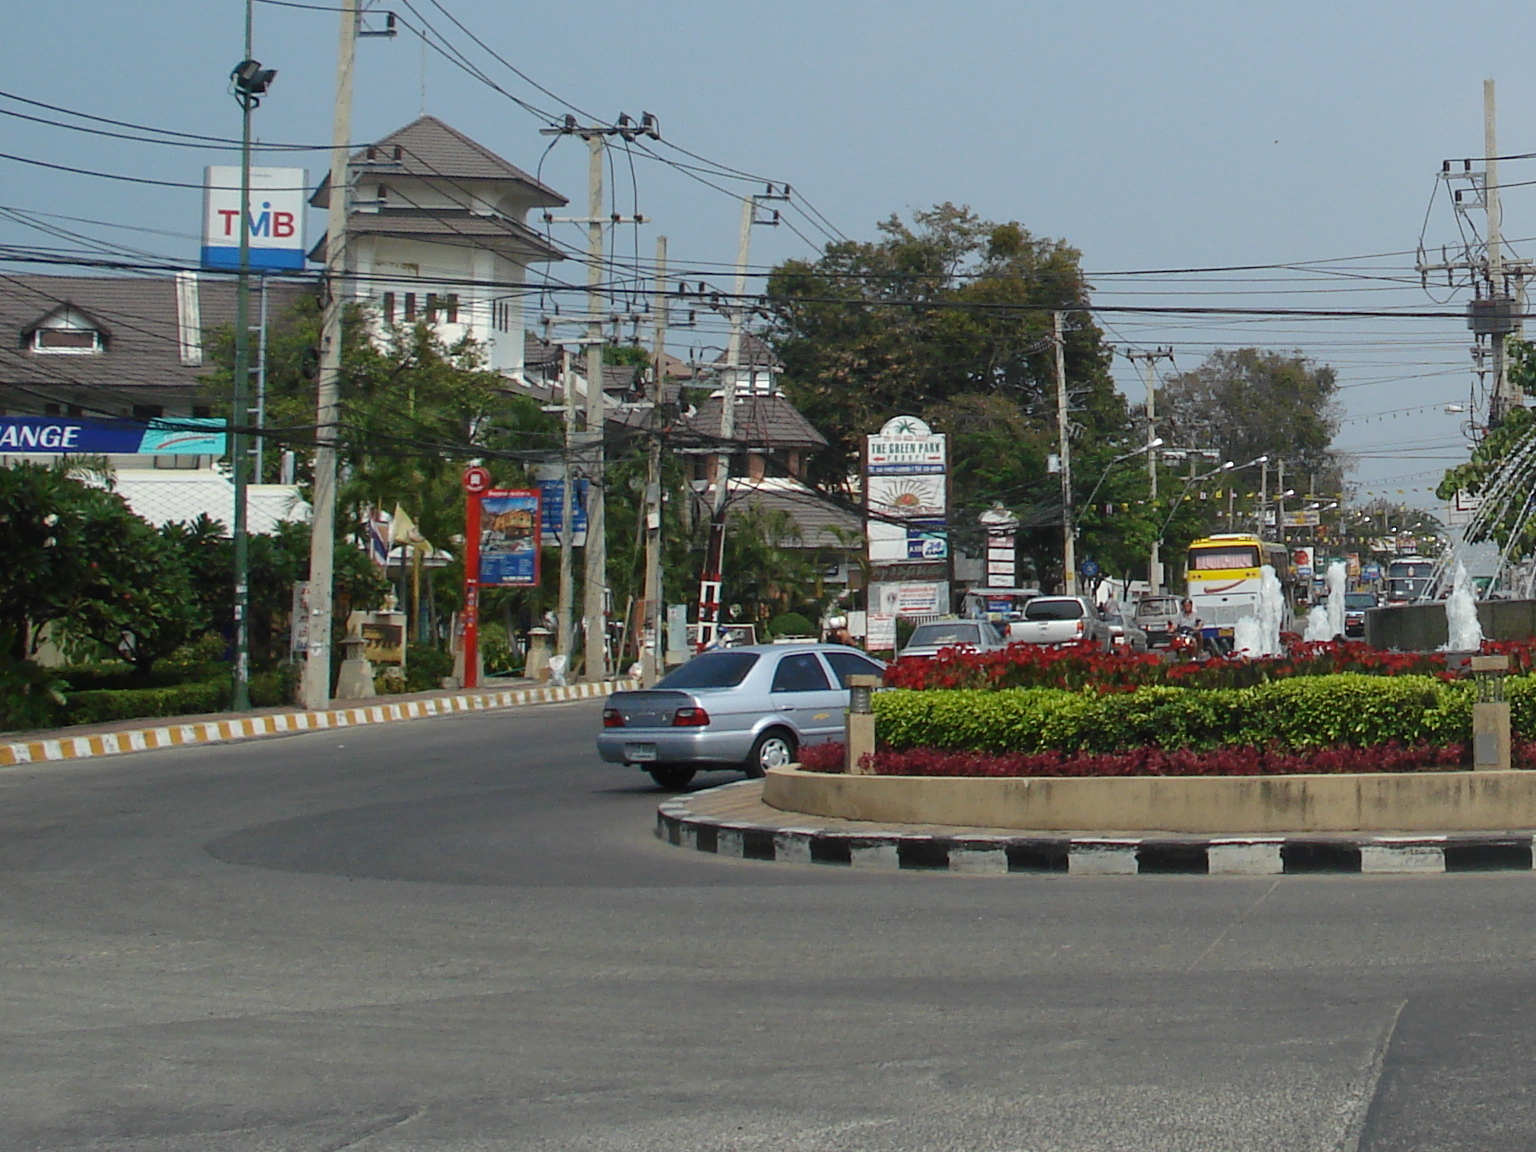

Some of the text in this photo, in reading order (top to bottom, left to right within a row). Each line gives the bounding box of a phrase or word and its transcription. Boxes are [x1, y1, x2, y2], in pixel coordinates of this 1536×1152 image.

[218, 201, 295, 237] TMB
[0, 425, 81, 448] ANGE
[872, 442, 940, 454] THE GREEN PARK
